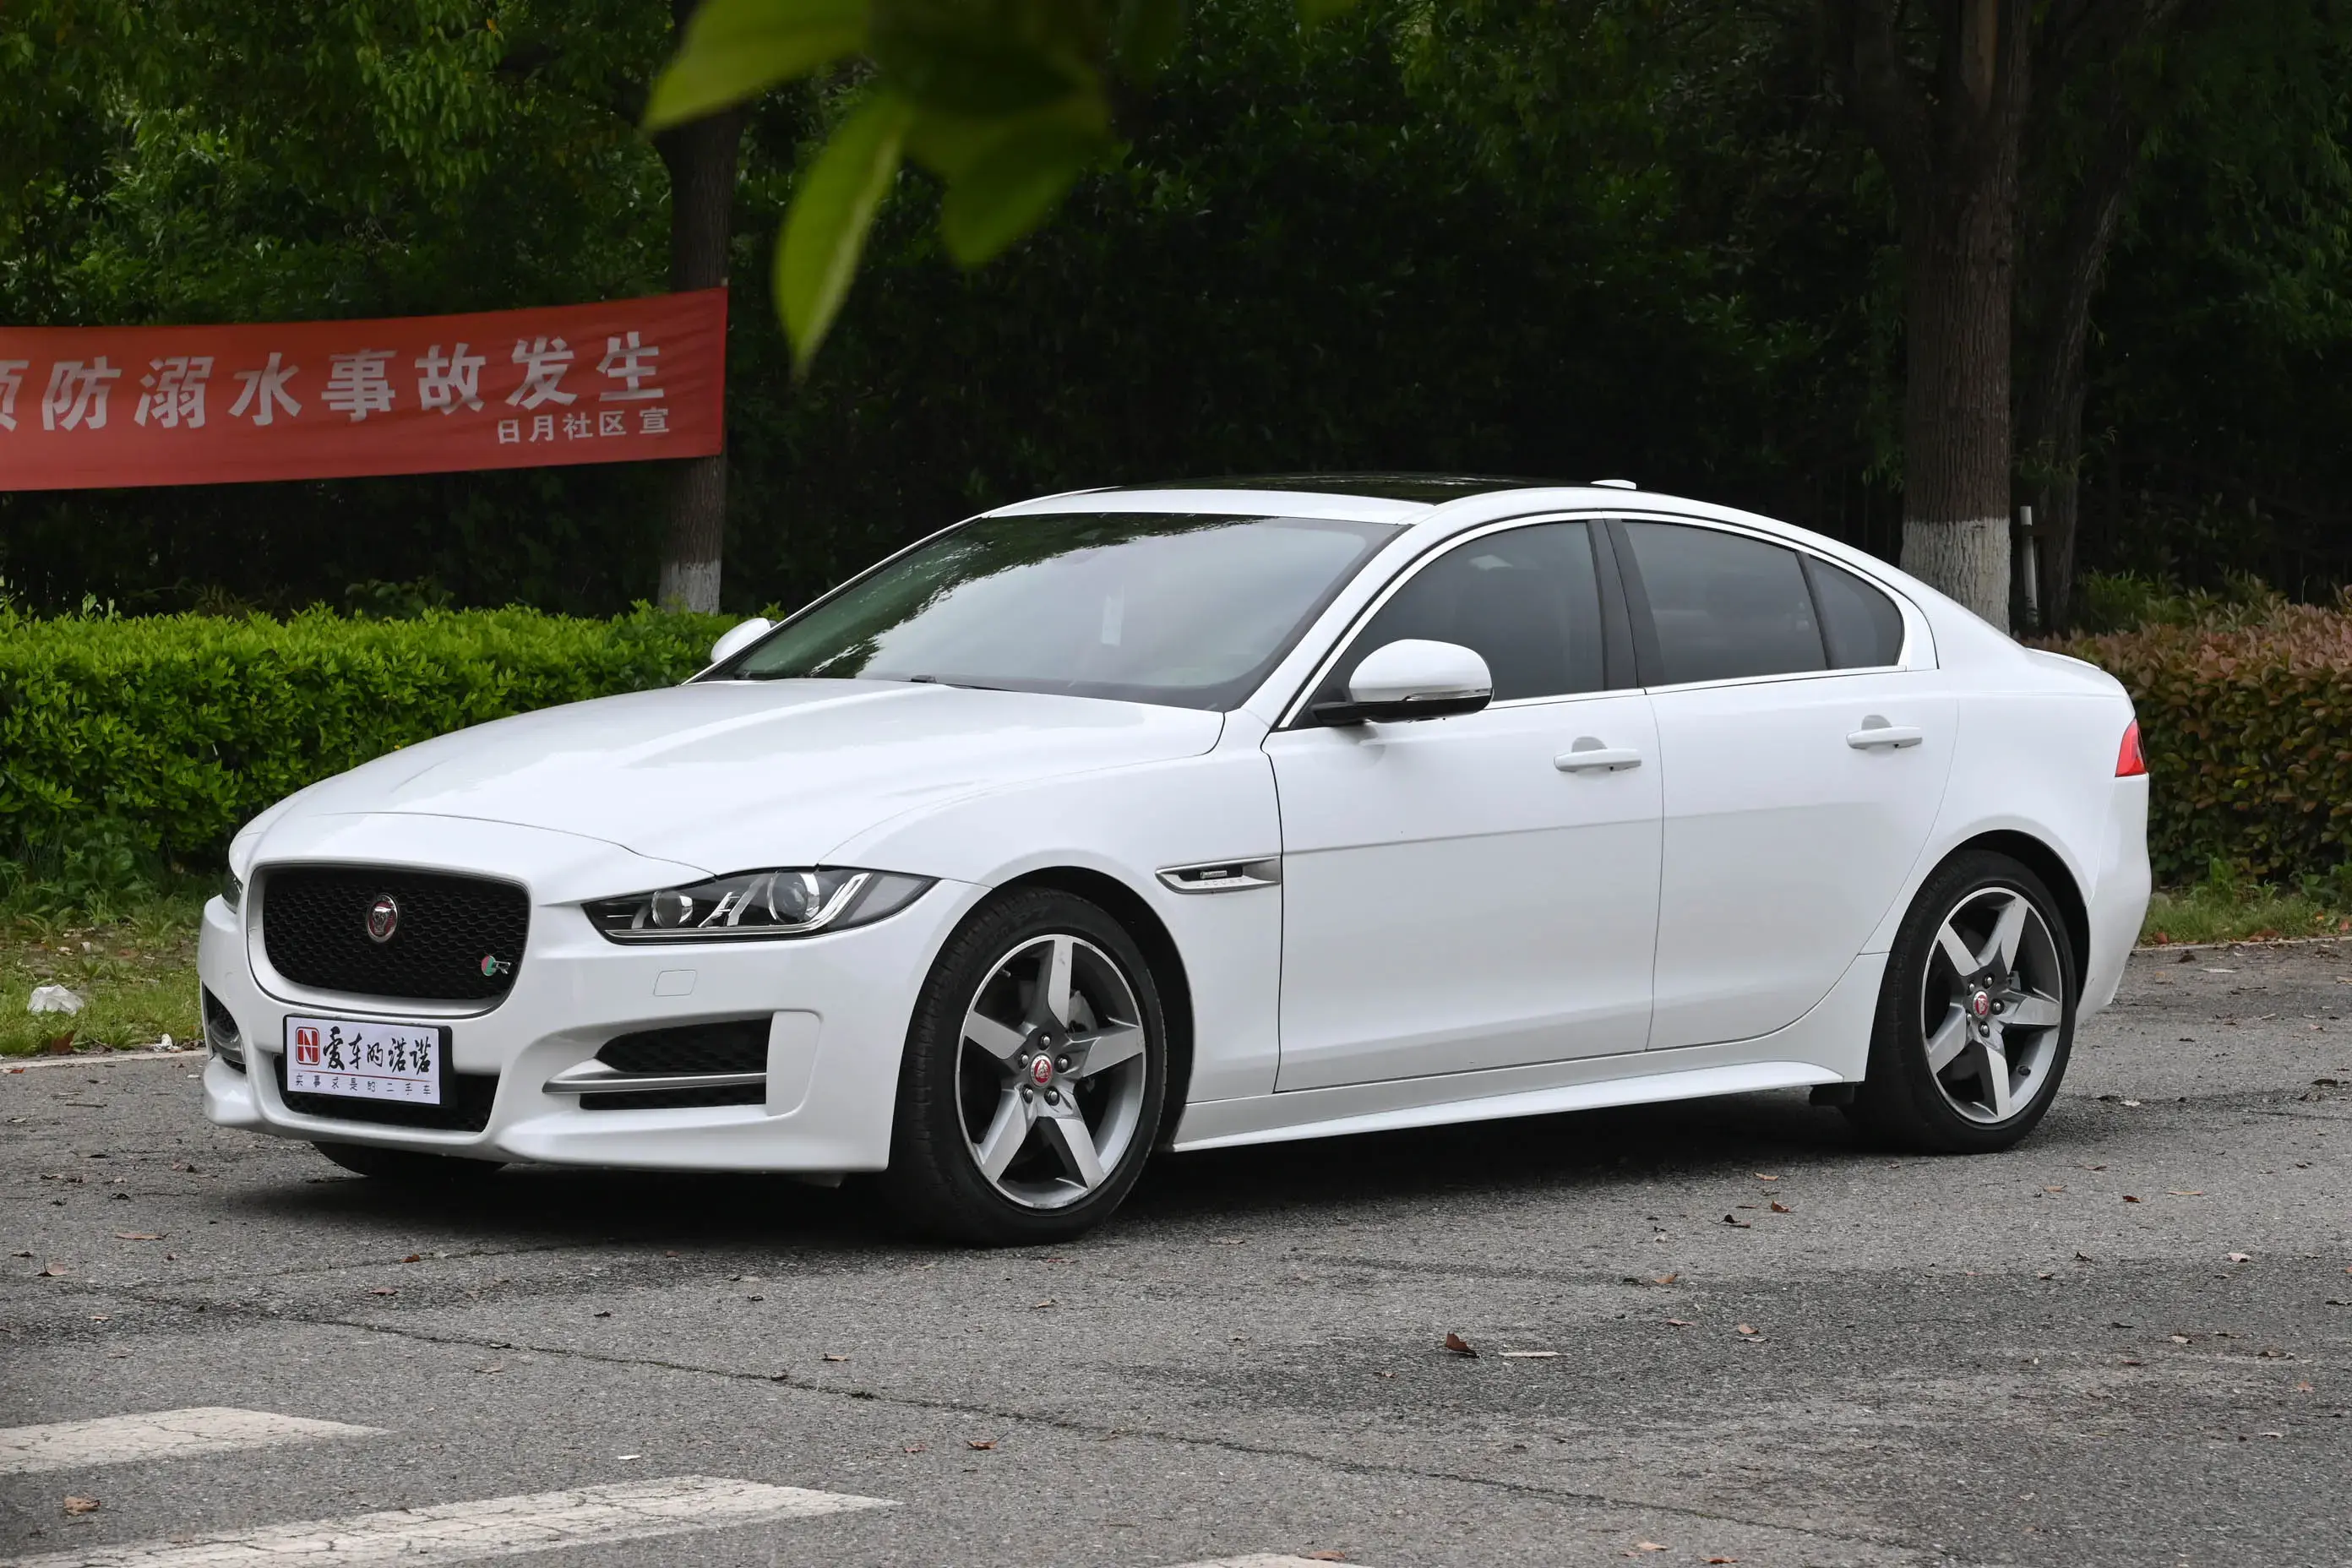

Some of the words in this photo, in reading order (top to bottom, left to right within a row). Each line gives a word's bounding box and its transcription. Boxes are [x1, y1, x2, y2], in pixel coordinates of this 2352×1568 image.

[498, 411, 626, 444] 日月社区
[640, 406, 669, 433] 宣
